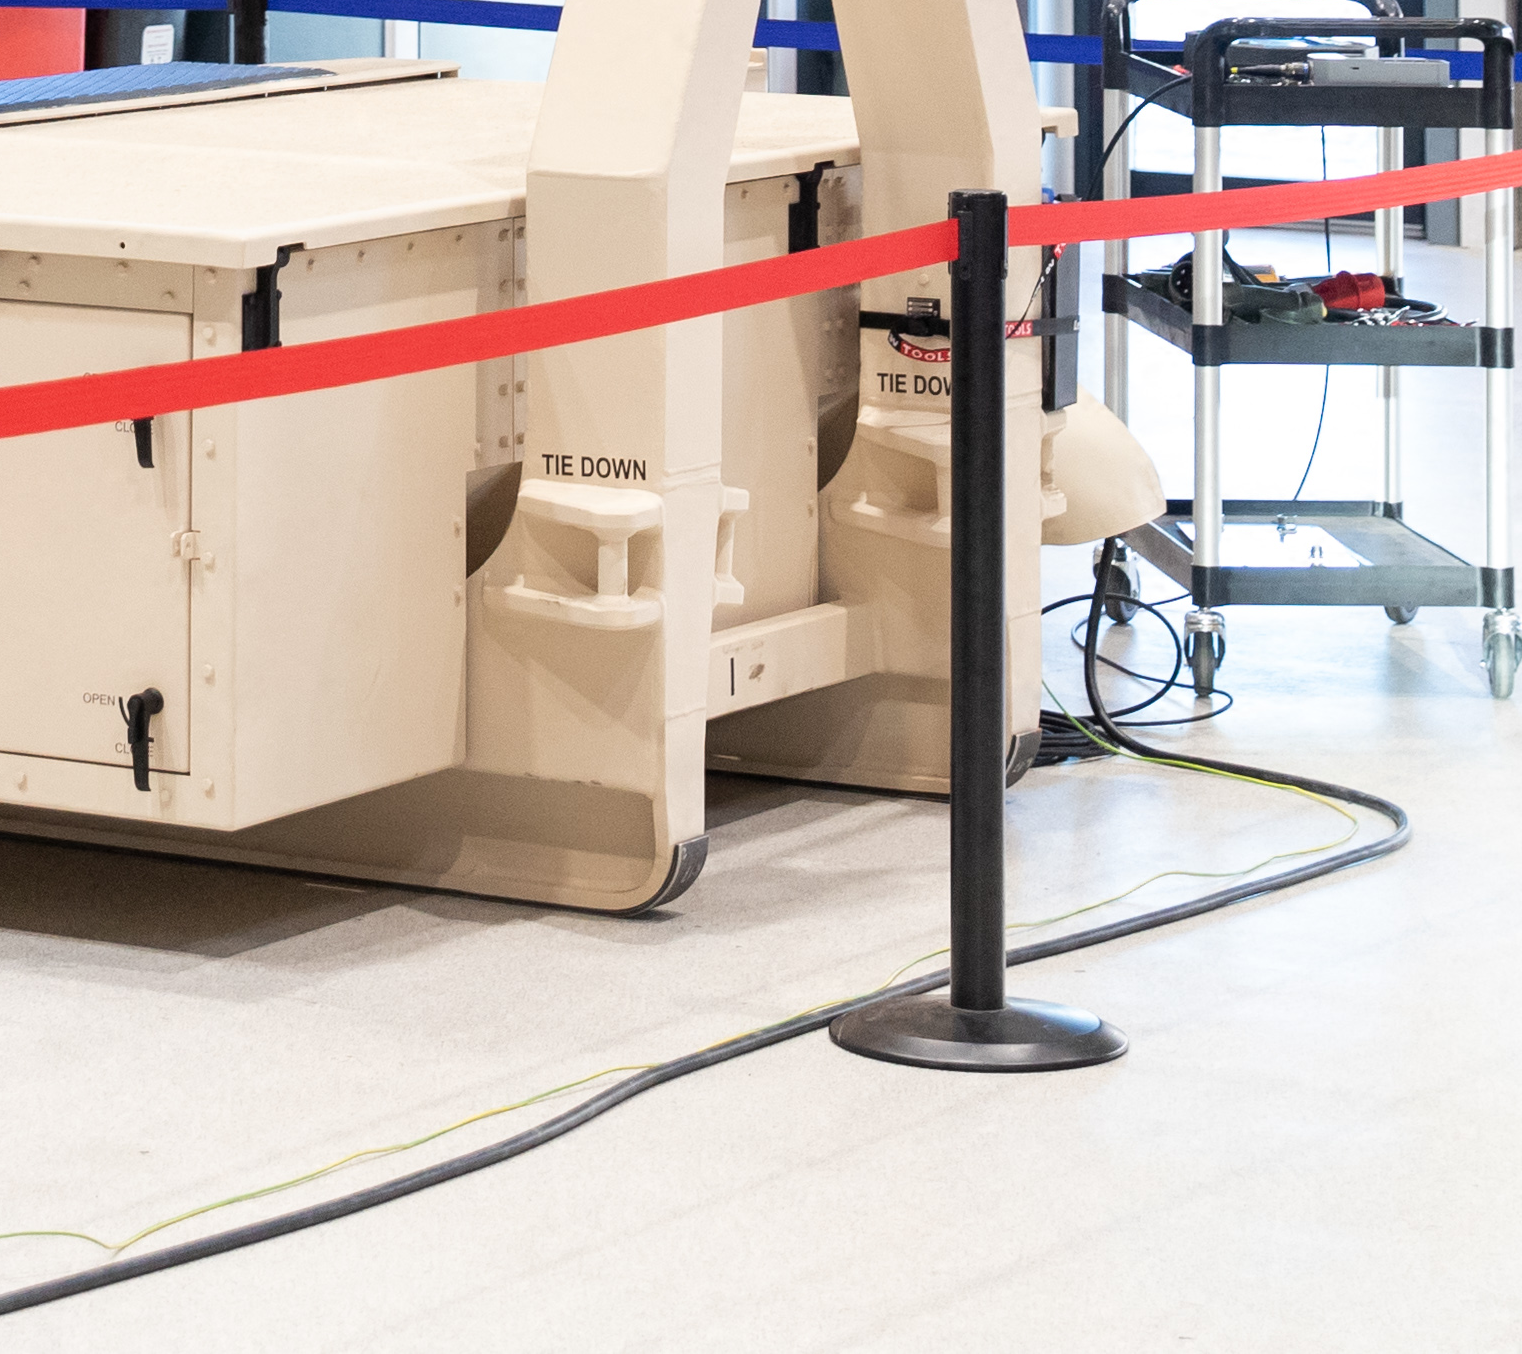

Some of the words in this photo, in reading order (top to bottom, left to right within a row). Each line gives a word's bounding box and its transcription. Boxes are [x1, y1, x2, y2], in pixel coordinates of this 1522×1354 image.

[876, 372, 907, 392] TIE
[541, 454, 573, 476] TIE
[581, 456, 646, 481] DOWN
[83, 692, 116, 706] OPEN
